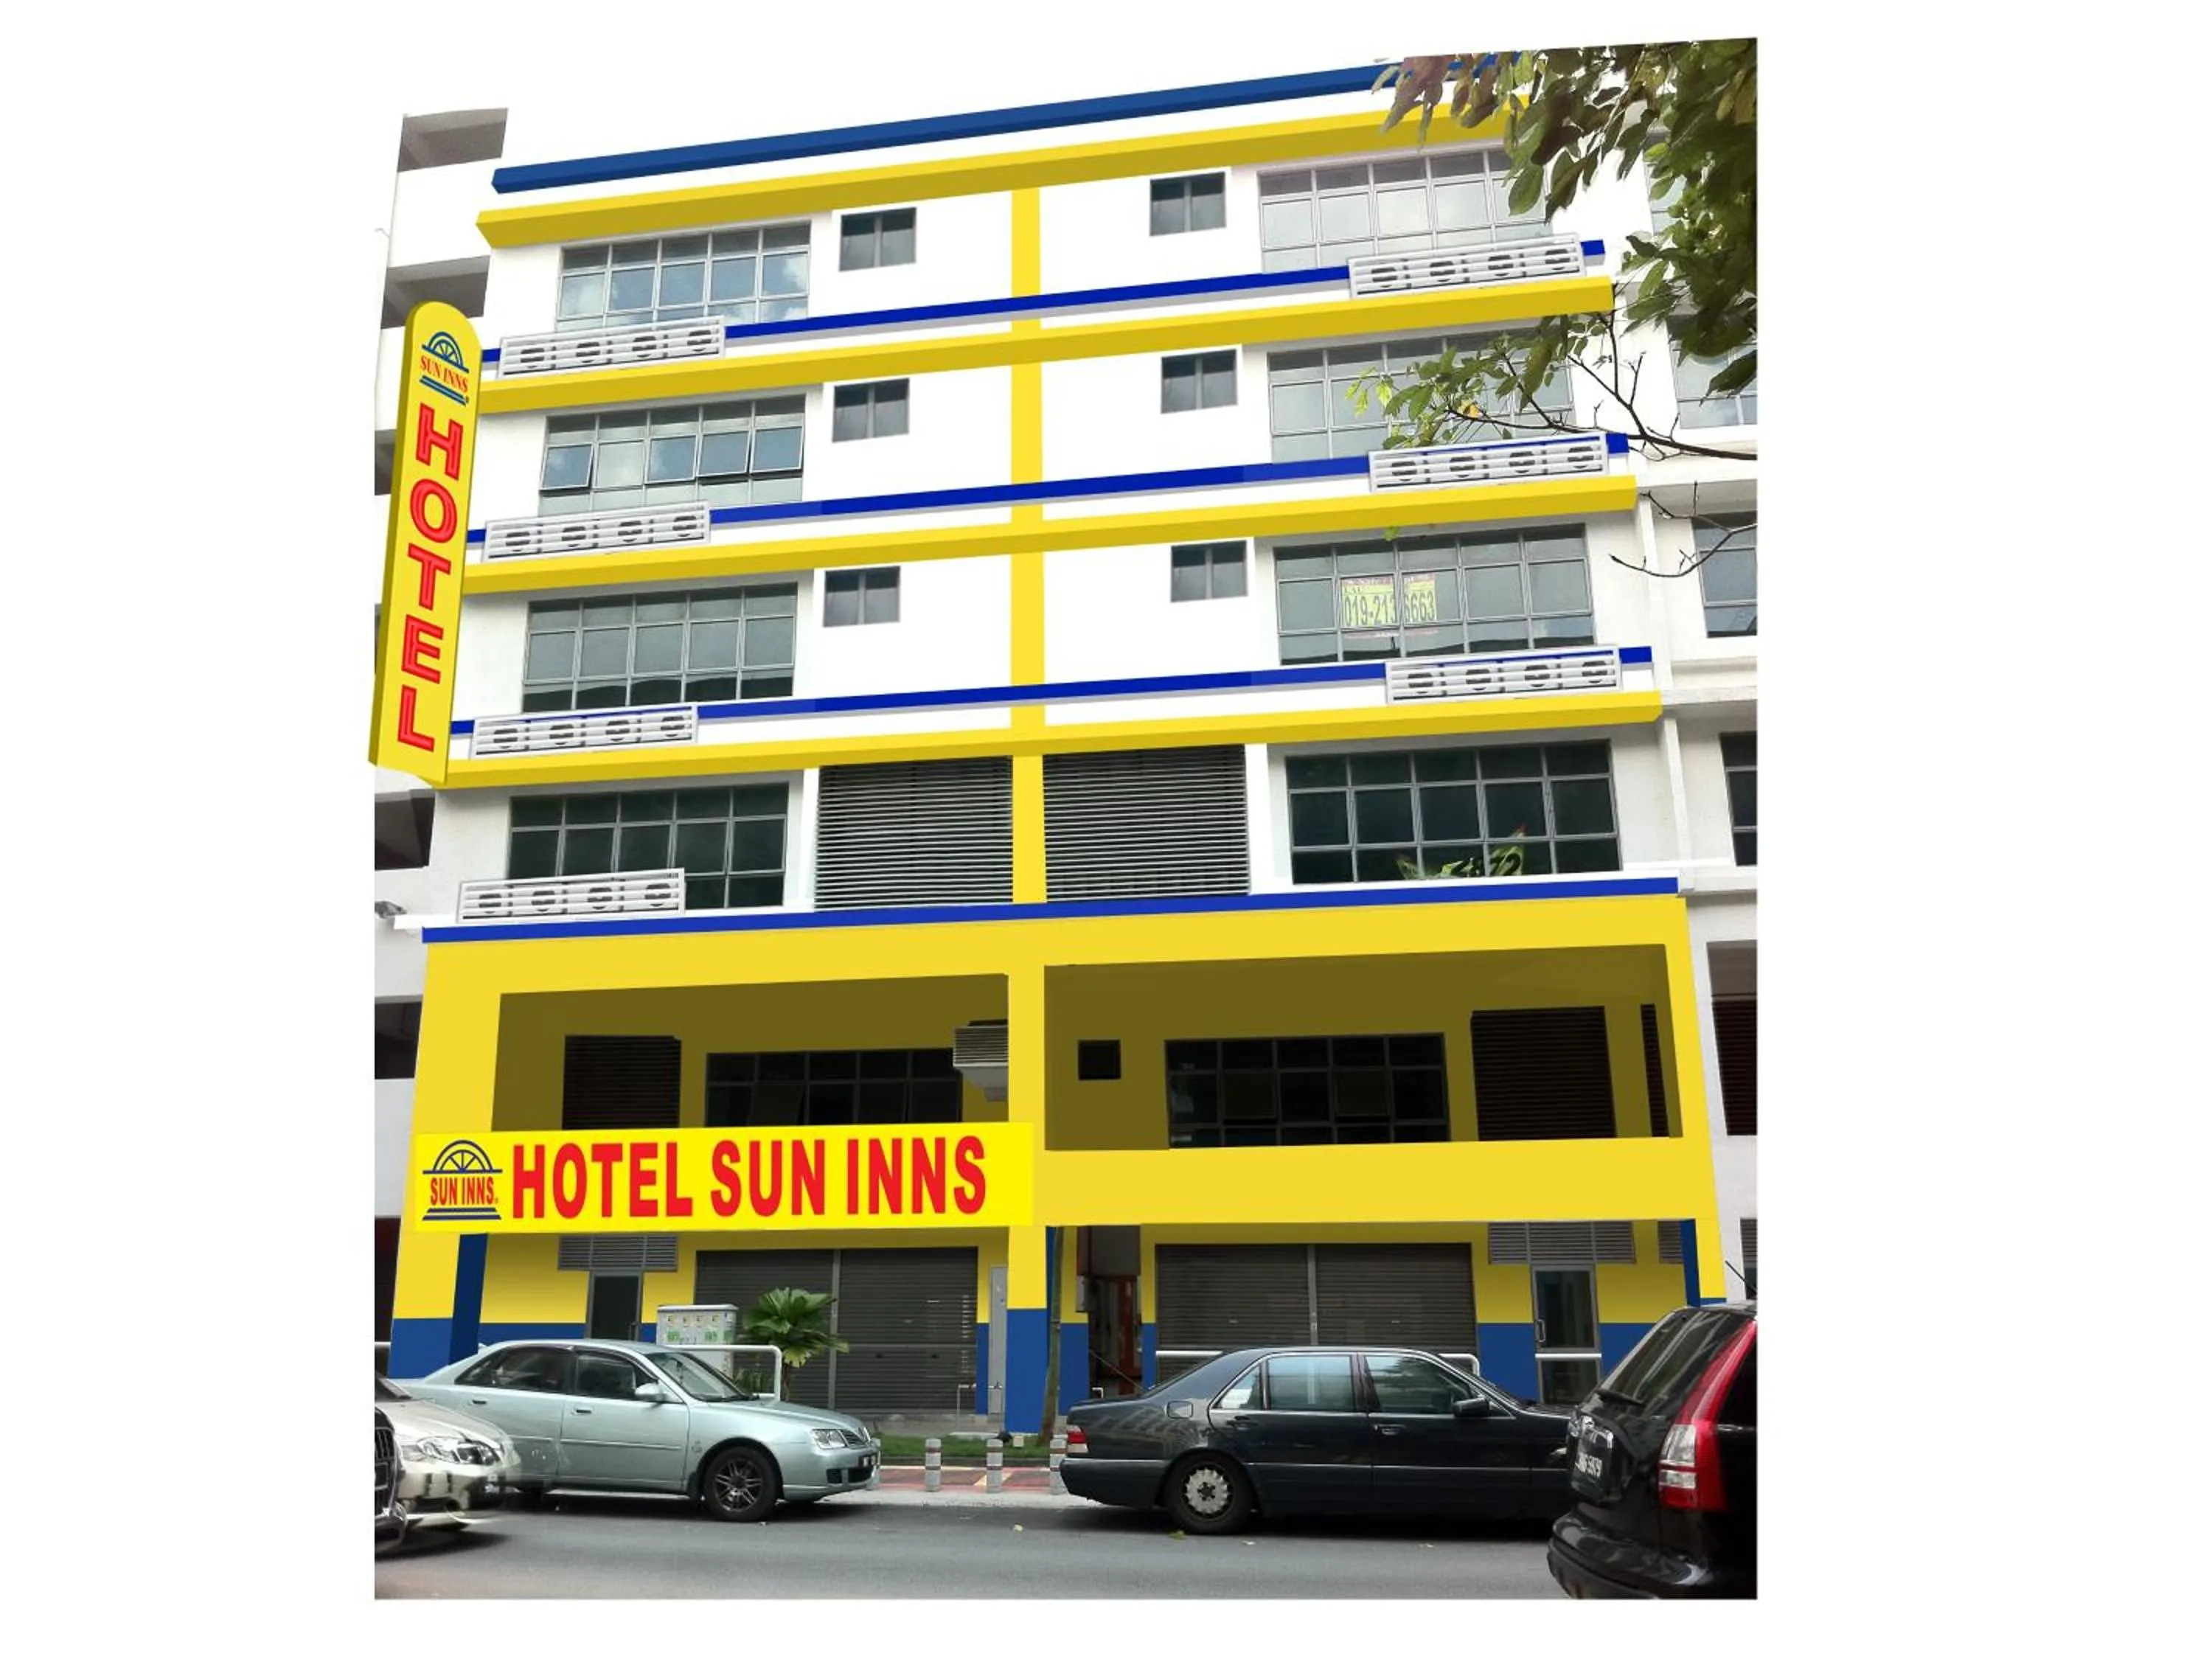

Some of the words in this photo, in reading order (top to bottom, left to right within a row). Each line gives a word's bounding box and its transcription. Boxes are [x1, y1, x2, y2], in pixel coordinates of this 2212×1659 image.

[420, 355, 440, 378] SUN
[443, 366, 468, 393] INNS
[397, 403, 465, 752] HOTEL
[431, 1178, 458, 1205] SUN
[462, 1177, 494, 1205] INNS
[512, 1143, 693, 1219] HOTEL
[711, 1140, 825, 1217] SUN
[847, 1135, 986, 1214] INNS
